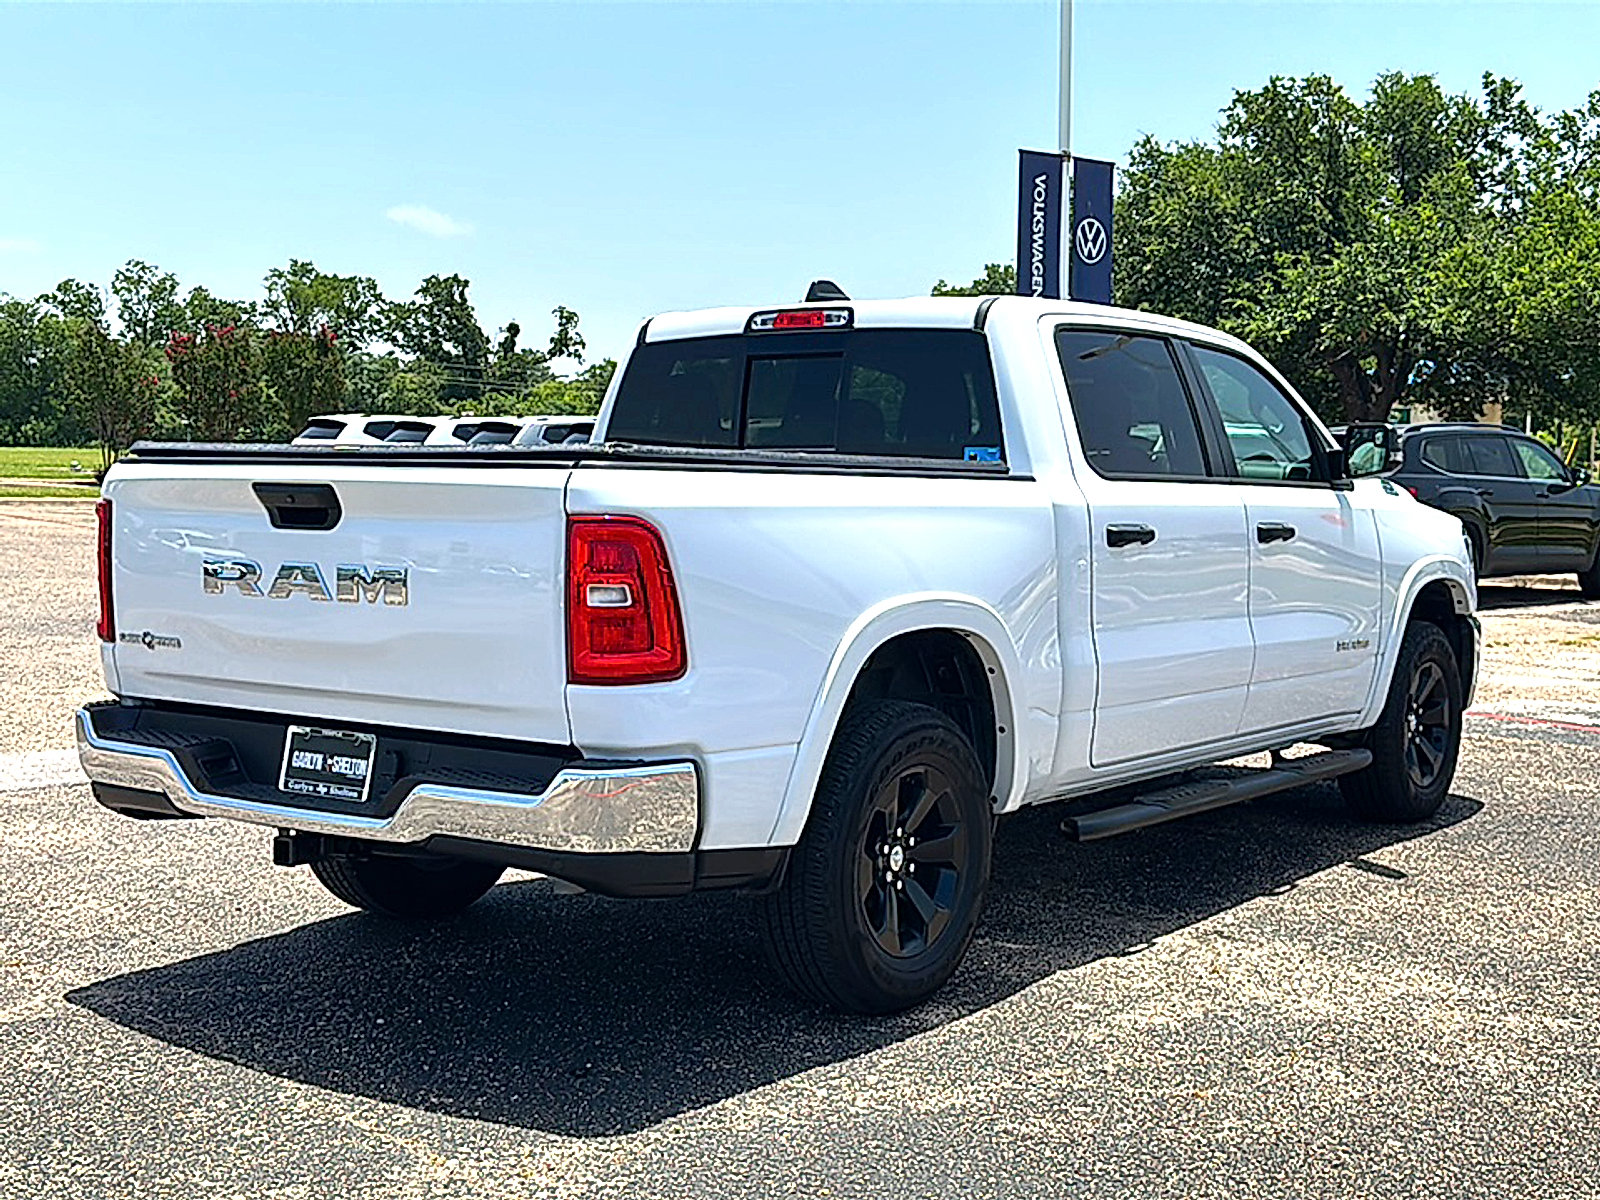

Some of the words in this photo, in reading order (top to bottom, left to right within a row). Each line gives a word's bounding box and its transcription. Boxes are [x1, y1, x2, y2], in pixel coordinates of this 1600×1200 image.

[1032, 174, 1047, 297] VOLKSWAGEN
[202, 559, 409, 606] RAM
[332, 756, 368, 775] SHELTON
